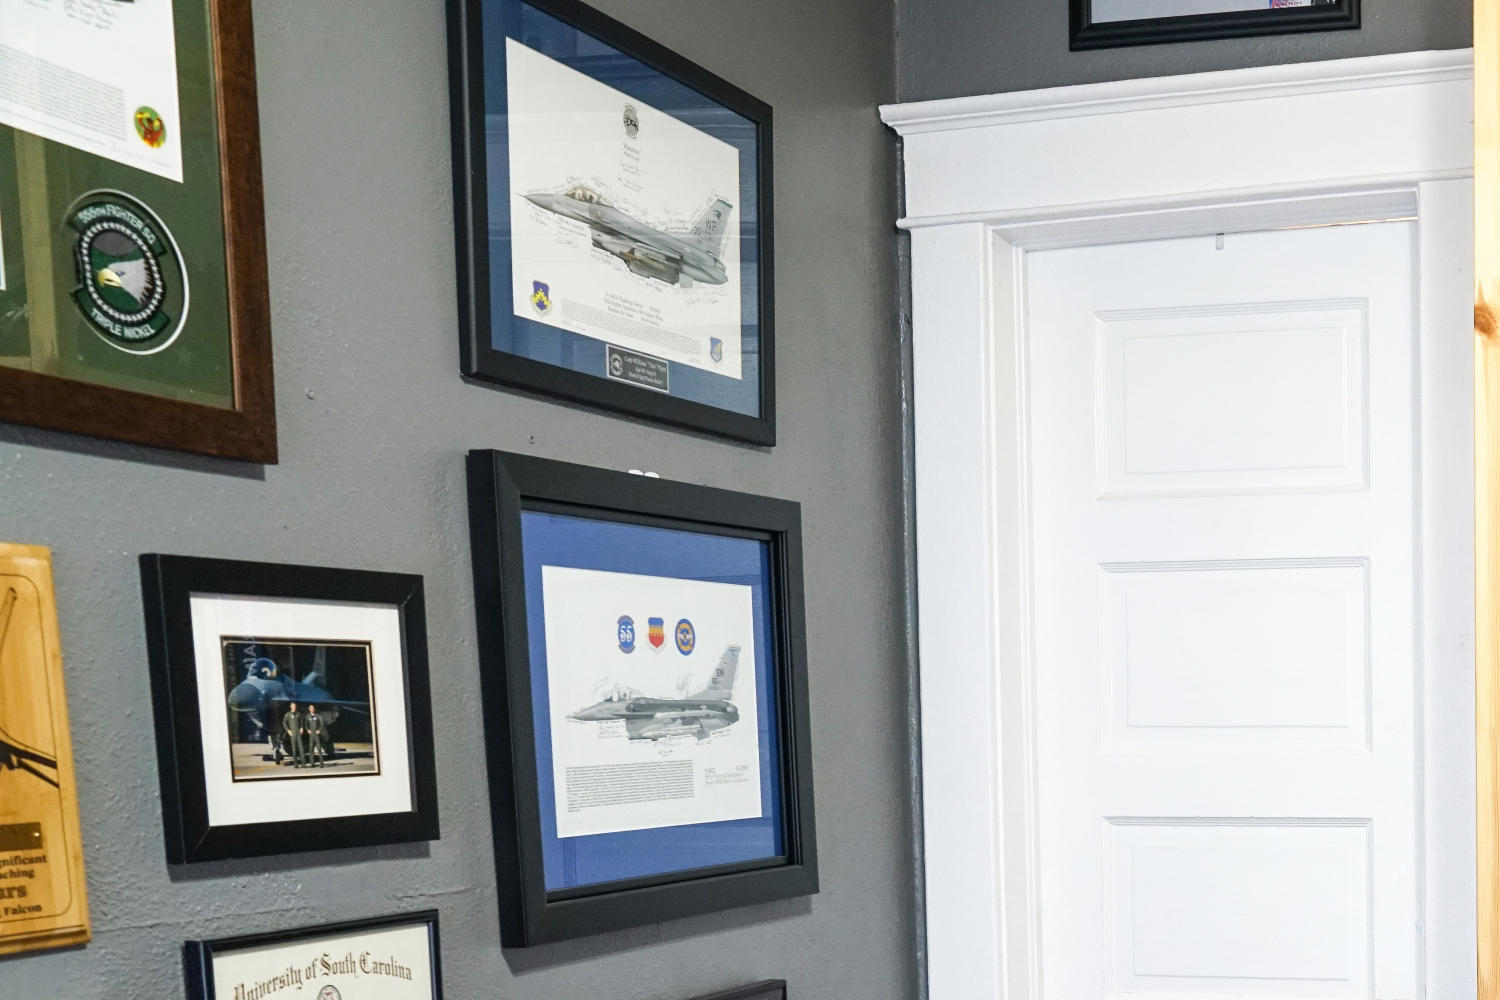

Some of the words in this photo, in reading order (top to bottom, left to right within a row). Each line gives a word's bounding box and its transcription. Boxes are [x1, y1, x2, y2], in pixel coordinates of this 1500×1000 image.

[106, 203, 144, 231] FIGHTER
[90, 309, 123, 338] TRIPLE
[123, 324, 156, 338] NICKEL
[4, 904, 42, 918] Falcon
[304, 958, 319, 981] of
[320, 951, 359, 977] South
[360, 951, 413, 981] Carolina
